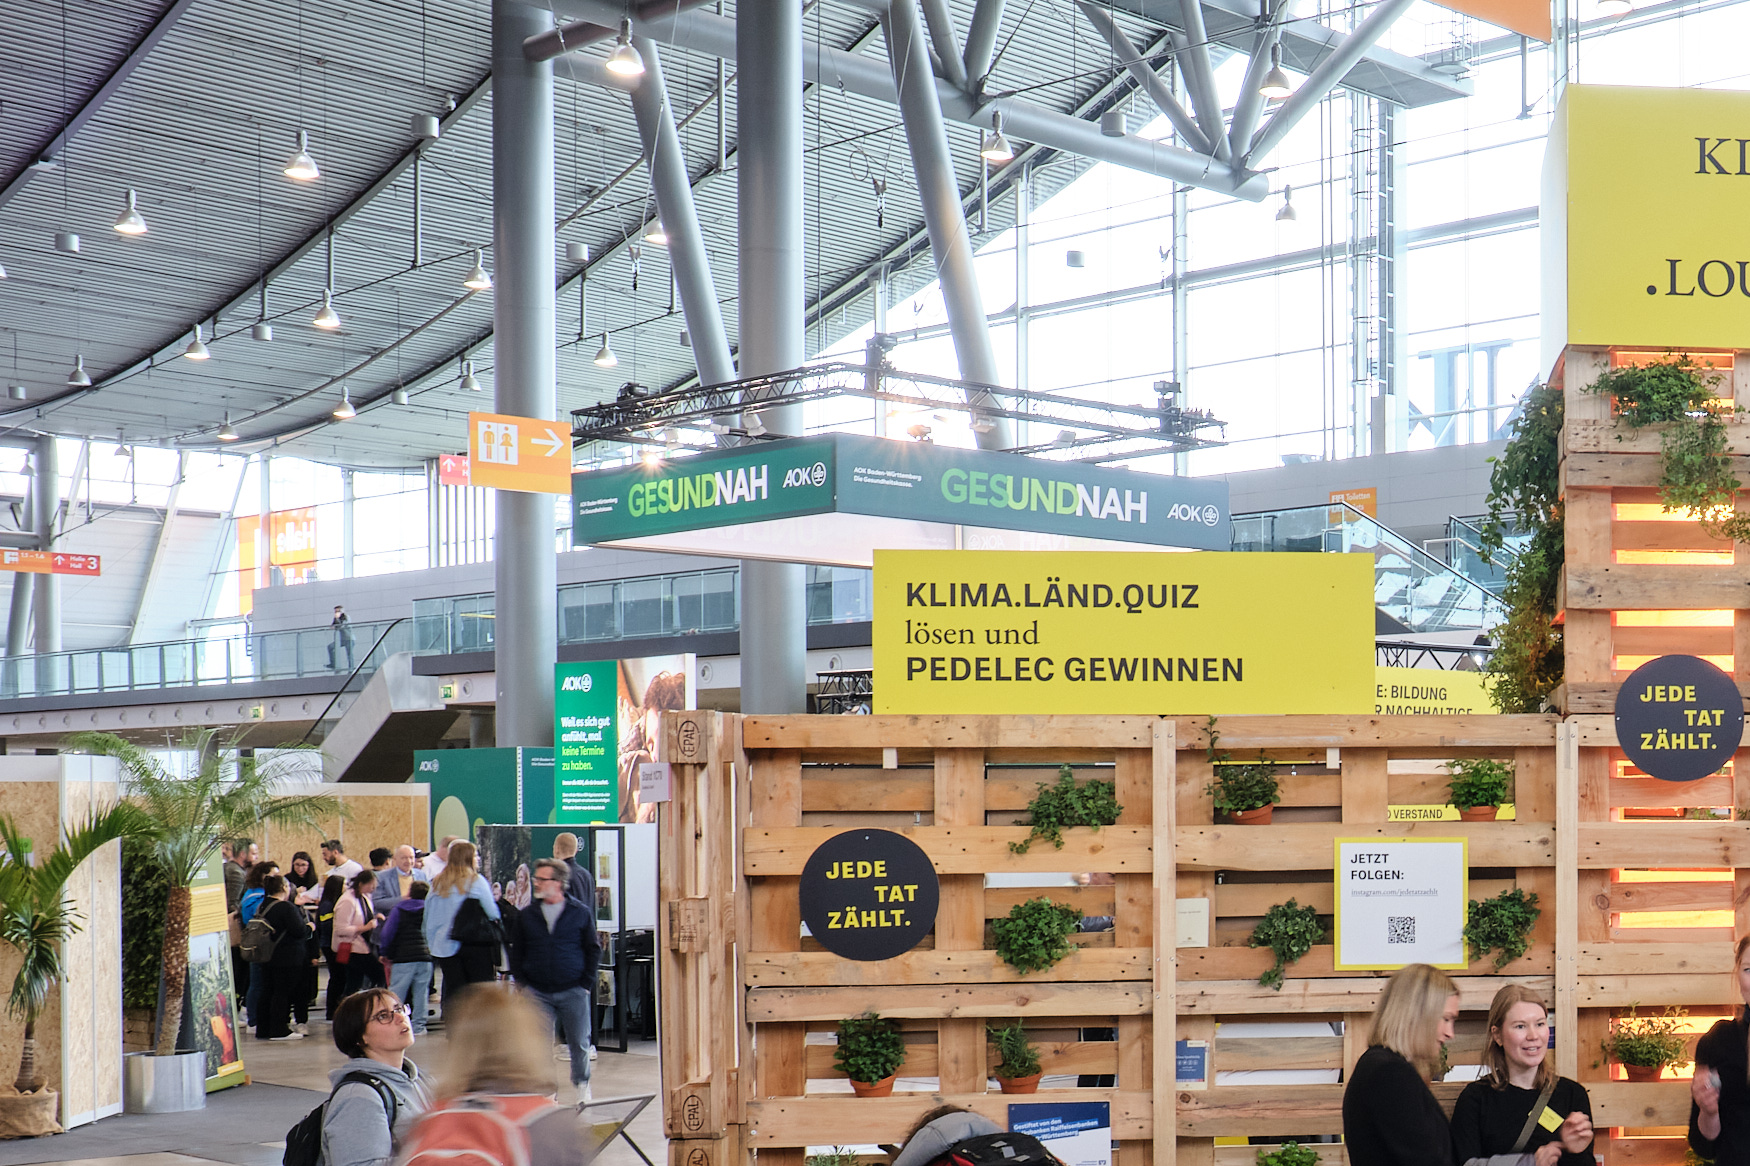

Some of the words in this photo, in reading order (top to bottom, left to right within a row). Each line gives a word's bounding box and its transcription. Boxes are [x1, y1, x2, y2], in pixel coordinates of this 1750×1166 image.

[782, 465, 812, 489] AOK
[628, 464, 768, 518] GESUNDNAH
[940, 468, 1148, 524] GESUNDNAH
[1166, 502, 1203, 522] AOK
[87, 556, 98, 570] 3
[906, 577, 1198, 613] KLIMA.LÄND.QUIZ
[905, 620, 975, 645] lösen
[985, 620, 1040, 645] und
[906, 657, 1054, 682] PEDELEC
[1064, 657, 1244, 682] GEWINNEN
[561, 676, 582, 691] AOK
[1391, 685, 1447, 700] BILDUNG
[1640, 685, 1697, 702] JEDE
[1683, 709, 1725, 726] TAT
[683, 727, 696, 754] EPAL
[1640, 728, 1717, 750] ZÄHLT.
[562, 746, 579, 756] keine
[579, 745, 605, 756] Termine
[1394, 809, 1442, 819] VERSTAND
[1350, 854, 1389, 864] JETZT
[826, 860, 887, 879] JEDE
[1351, 870, 1404, 880] FOLGEN:
[874, 884, 919, 903] TAT
[827, 906, 911, 929] ZÄHLT.
[687, 1100, 699, 1128] EPAL
[1013, 1121, 1039, 1131] Gestiftet
